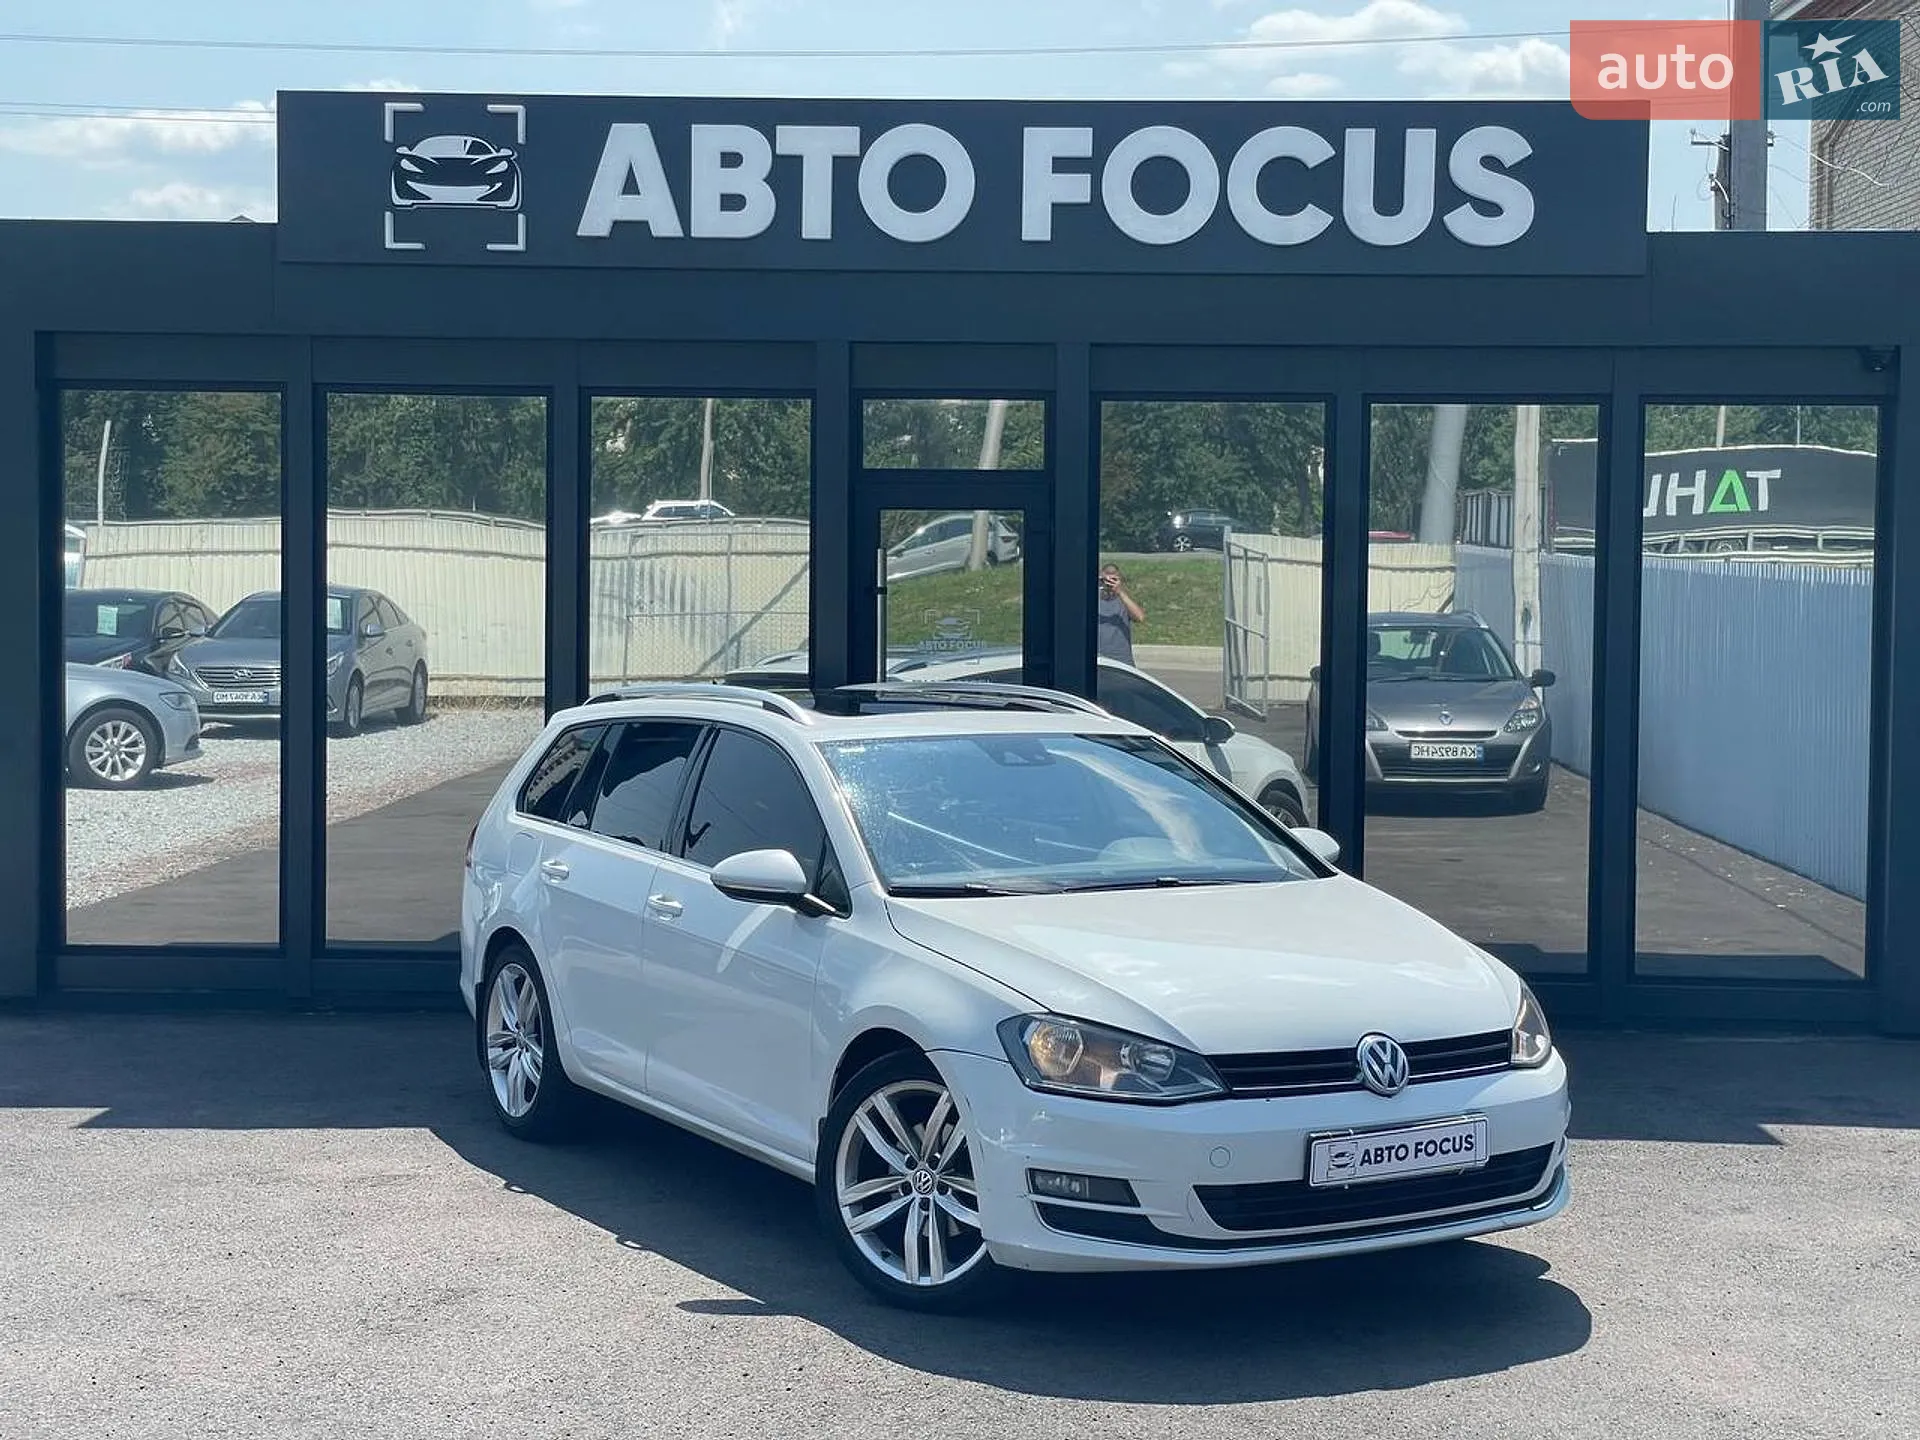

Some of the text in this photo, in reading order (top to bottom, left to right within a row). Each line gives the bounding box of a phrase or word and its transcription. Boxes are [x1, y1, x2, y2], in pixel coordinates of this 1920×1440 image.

[576, 123, 1536, 248] АВТО FOCUS
[1360, 1134, 1474, 1167] АВТО FOCUS
